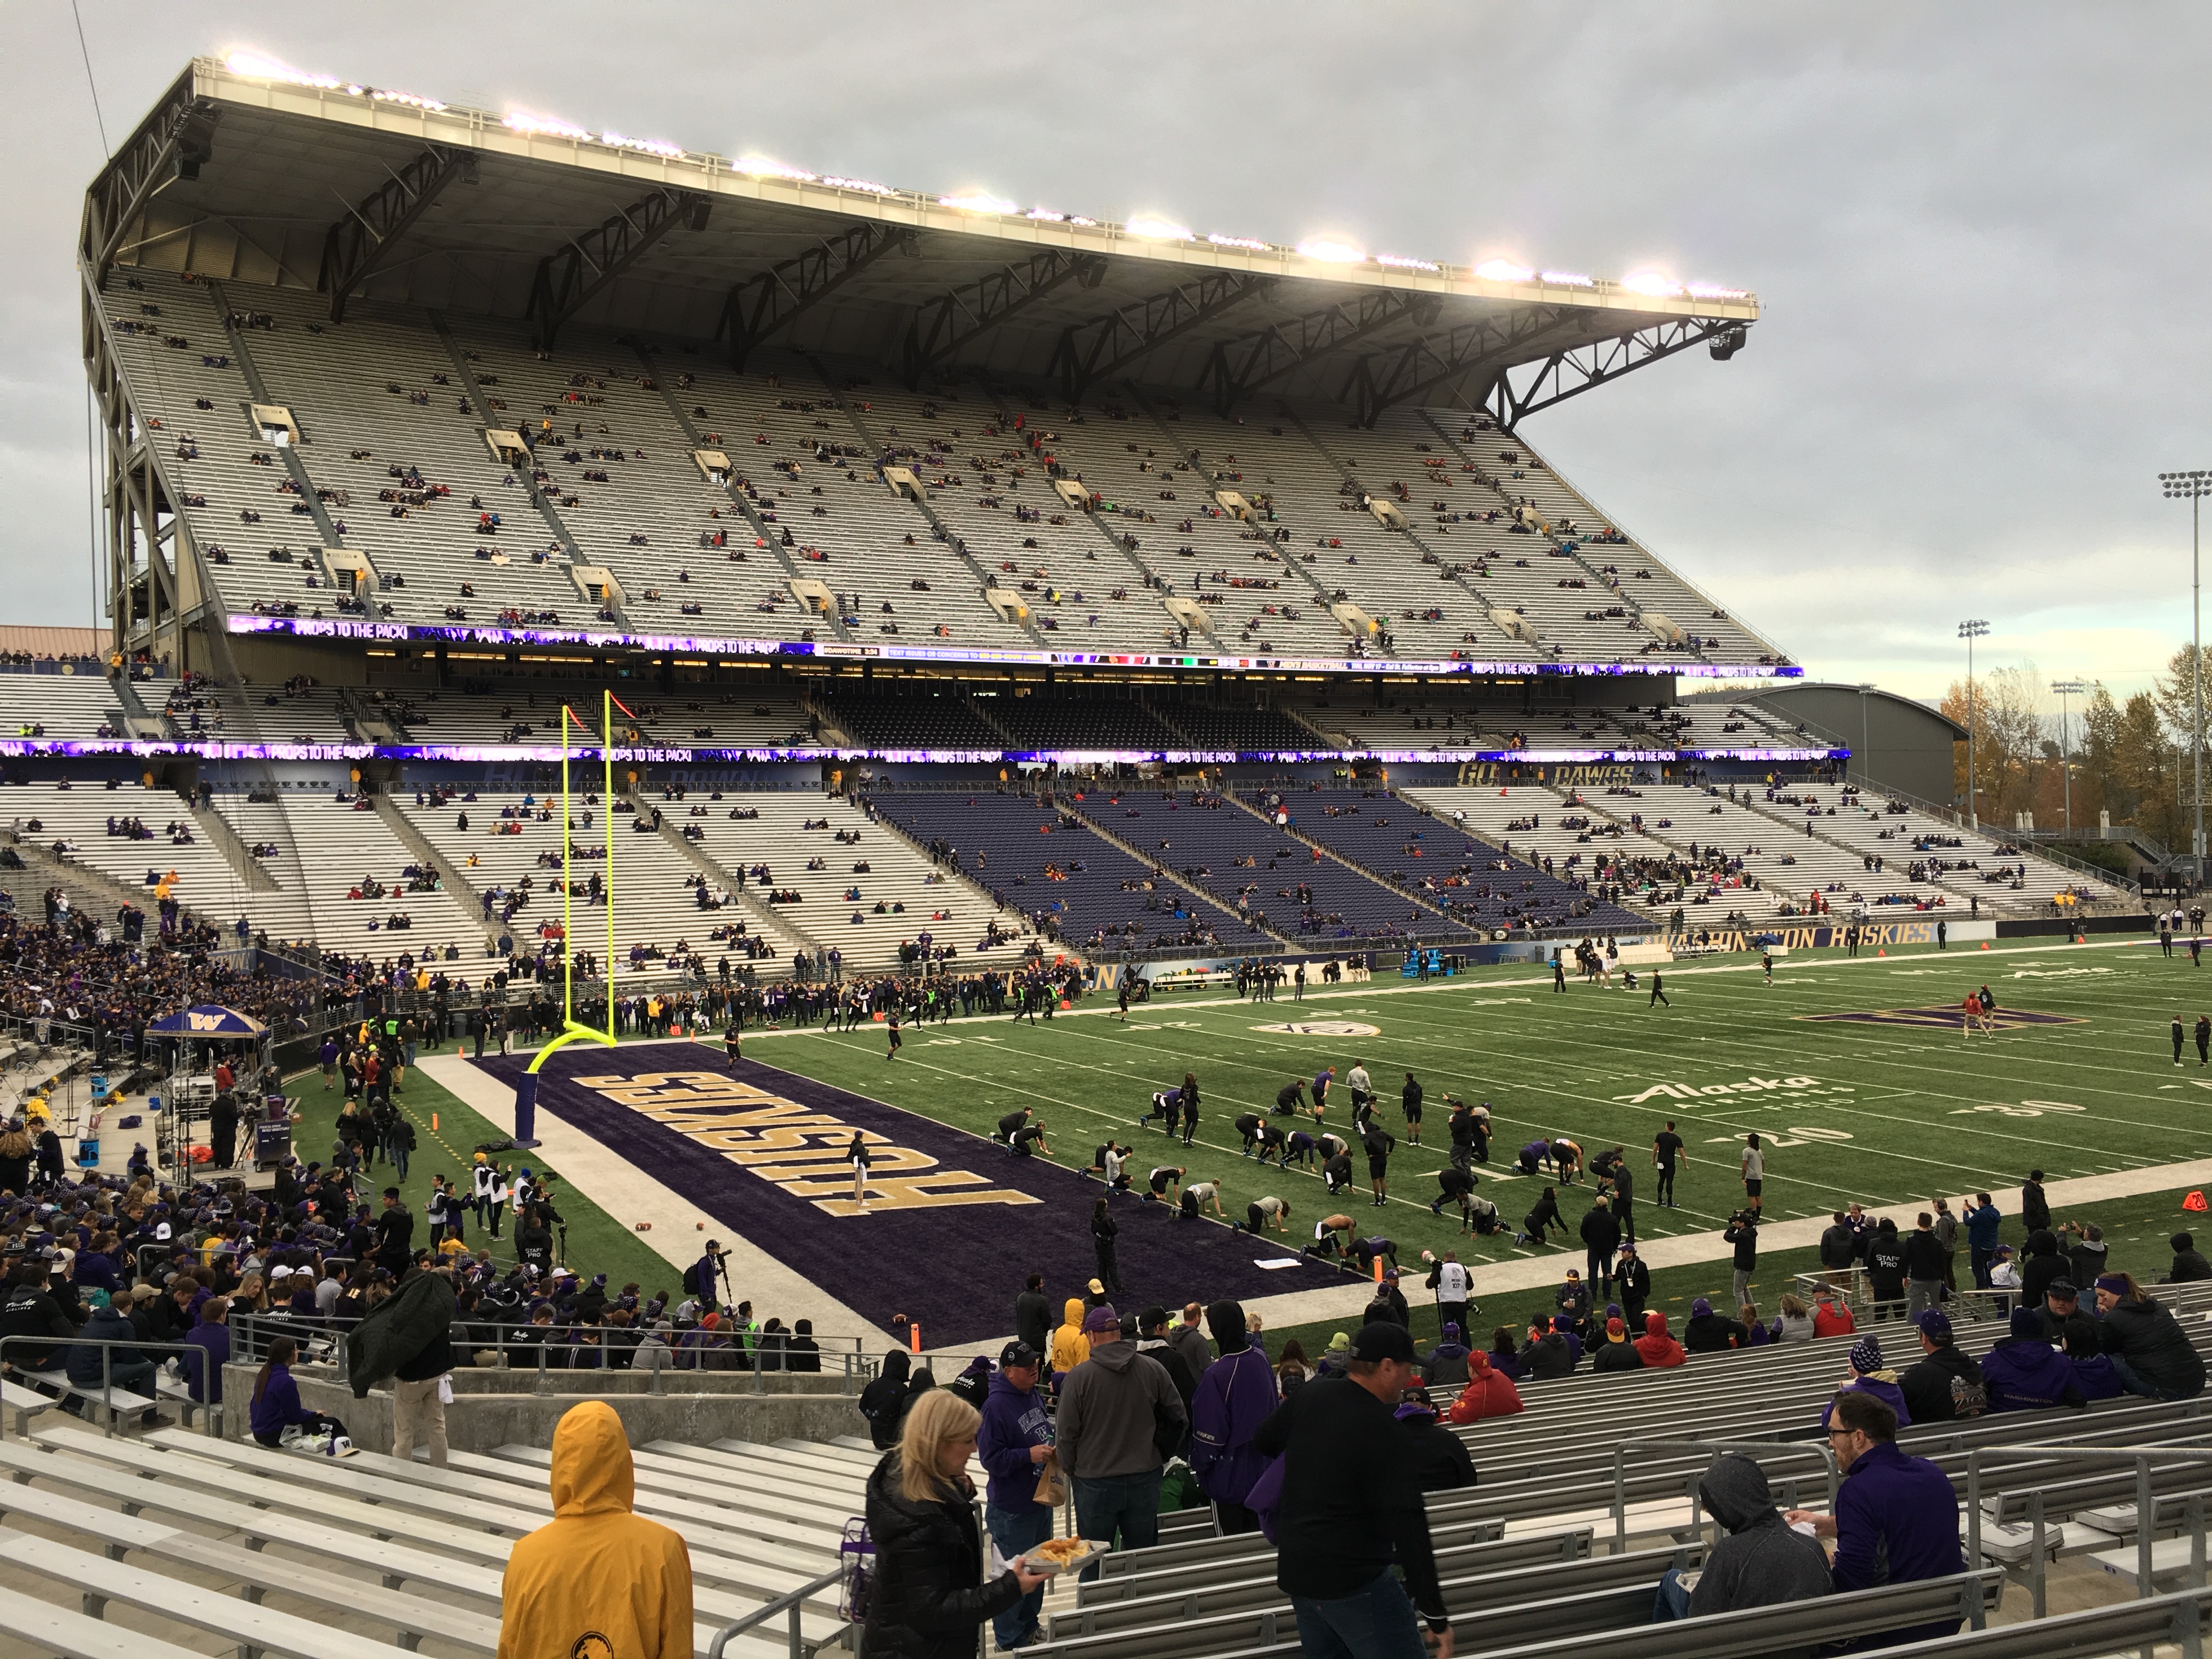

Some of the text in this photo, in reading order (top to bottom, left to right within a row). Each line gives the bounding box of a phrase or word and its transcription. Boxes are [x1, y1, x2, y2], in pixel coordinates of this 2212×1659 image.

[296, 620, 408, 640] PROPS TO THE PACK!
[696, 639, 726, 653] PROPS
[726, 641, 737, 653] TO
[737, 641, 754, 654] THE
[823, 646, 862, 654] #DAWGTIME
[1472, 663, 1537, 675] PROPS TO THE PACK!
[1719, 667, 1739, 677] PROPS
[1739, 667, 1747, 677] TO
[1746, 667, 1758, 677] THE
[271, 745, 308, 759] PROPS
[307, 746, 321, 759] TO
[321, 746, 343, 759] THE
[634, 749, 646, 761] TO
[646, 749, 664, 762] THE
[666, 750, 692, 762] PACK!
[930, 751, 955, 763] PROPS
[955, 752, 965, 763] TO
[965, 752, 980, 763] THE
[1166, 752, 1236, 763] PROPS TO THE PACK!
[1417, 752, 1438, 762] PROPS
[1437, 753, 1445, 763] TO
[1445, 753, 1457, 763] THE
[1615, 751, 1675, 761] PROPS TO THE PACK!
[1773, 751, 1792, 760] PROPS
[1792, 751, 1799, 760] TO
[1799, 751, 1810, 760] THE
[1457, 763, 1634, 787] GO DAWGS
[188, 1012, 226, 1031] W
[1129, 1021, 1202, 1030] 20
[1611, 1076, 1822, 1103] Alaska
[1674, 1087, 1856, 1109] AIRLINES
[1763, 1098, 1855, 1111] FIELD
[1973, 1100, 2087, 1117] 30
[1734, 1127, 1854, 1148] 20
[569, 1071, 1045, 1217] HUSKIES
[2192, 1194, 2205, 1209] 20
[1875, 1254, 1900, 1262] STAFF
[1880, 1260, 1898, 1268] PRO
[1017, 1343, 1030, 1353] W
[2004, 1393, 2053, 1404] WASHINGTON
[341, 1440, 350, 1449] W
